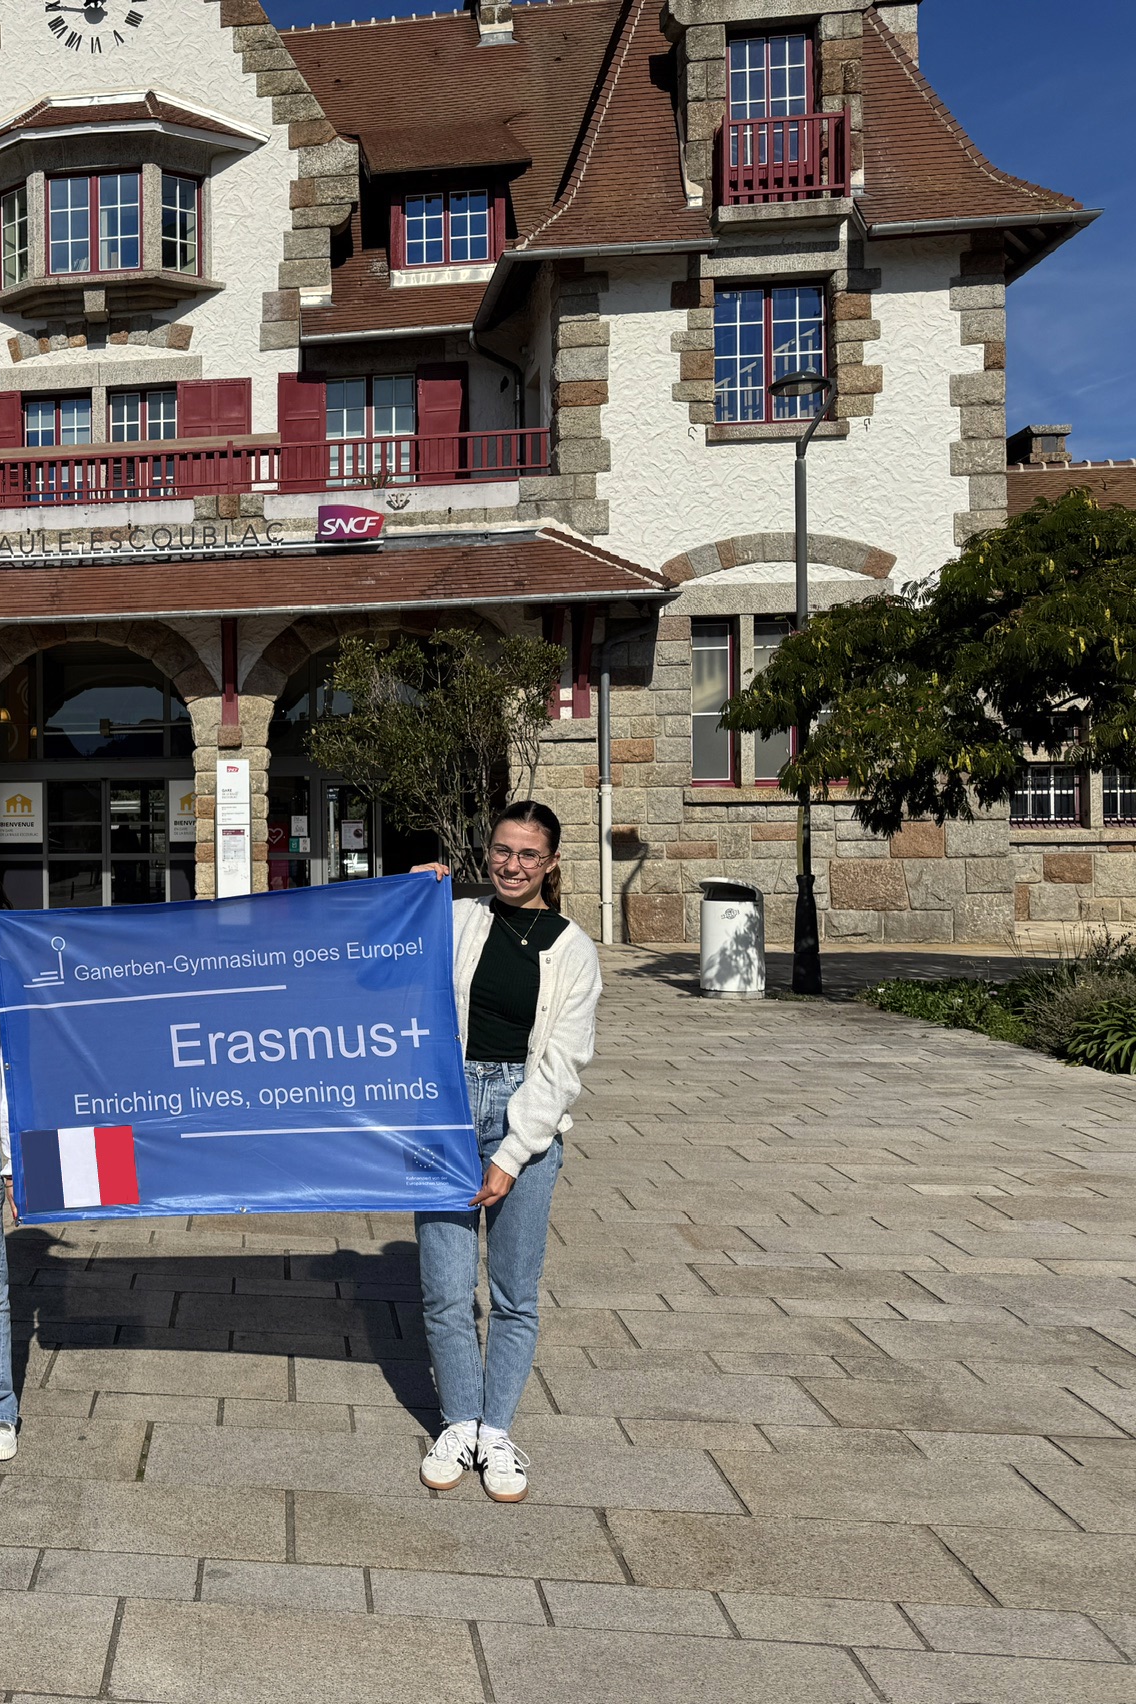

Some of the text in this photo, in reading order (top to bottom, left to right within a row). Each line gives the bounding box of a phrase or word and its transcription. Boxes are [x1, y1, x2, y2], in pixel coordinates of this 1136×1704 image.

[65, 31, 83, 51] VII
[90, 36, 102, 54] VI
[113, 29, 125, 47] V
[320, 516, 380, 536] SNCF
[74, 937, 424, 981] Ganerben-Gymnasium goes Europe!
[169, 1017, 431, 1068] Erasmus+
[74, 1077, 439, 1115] Enriching lives, opening minds
